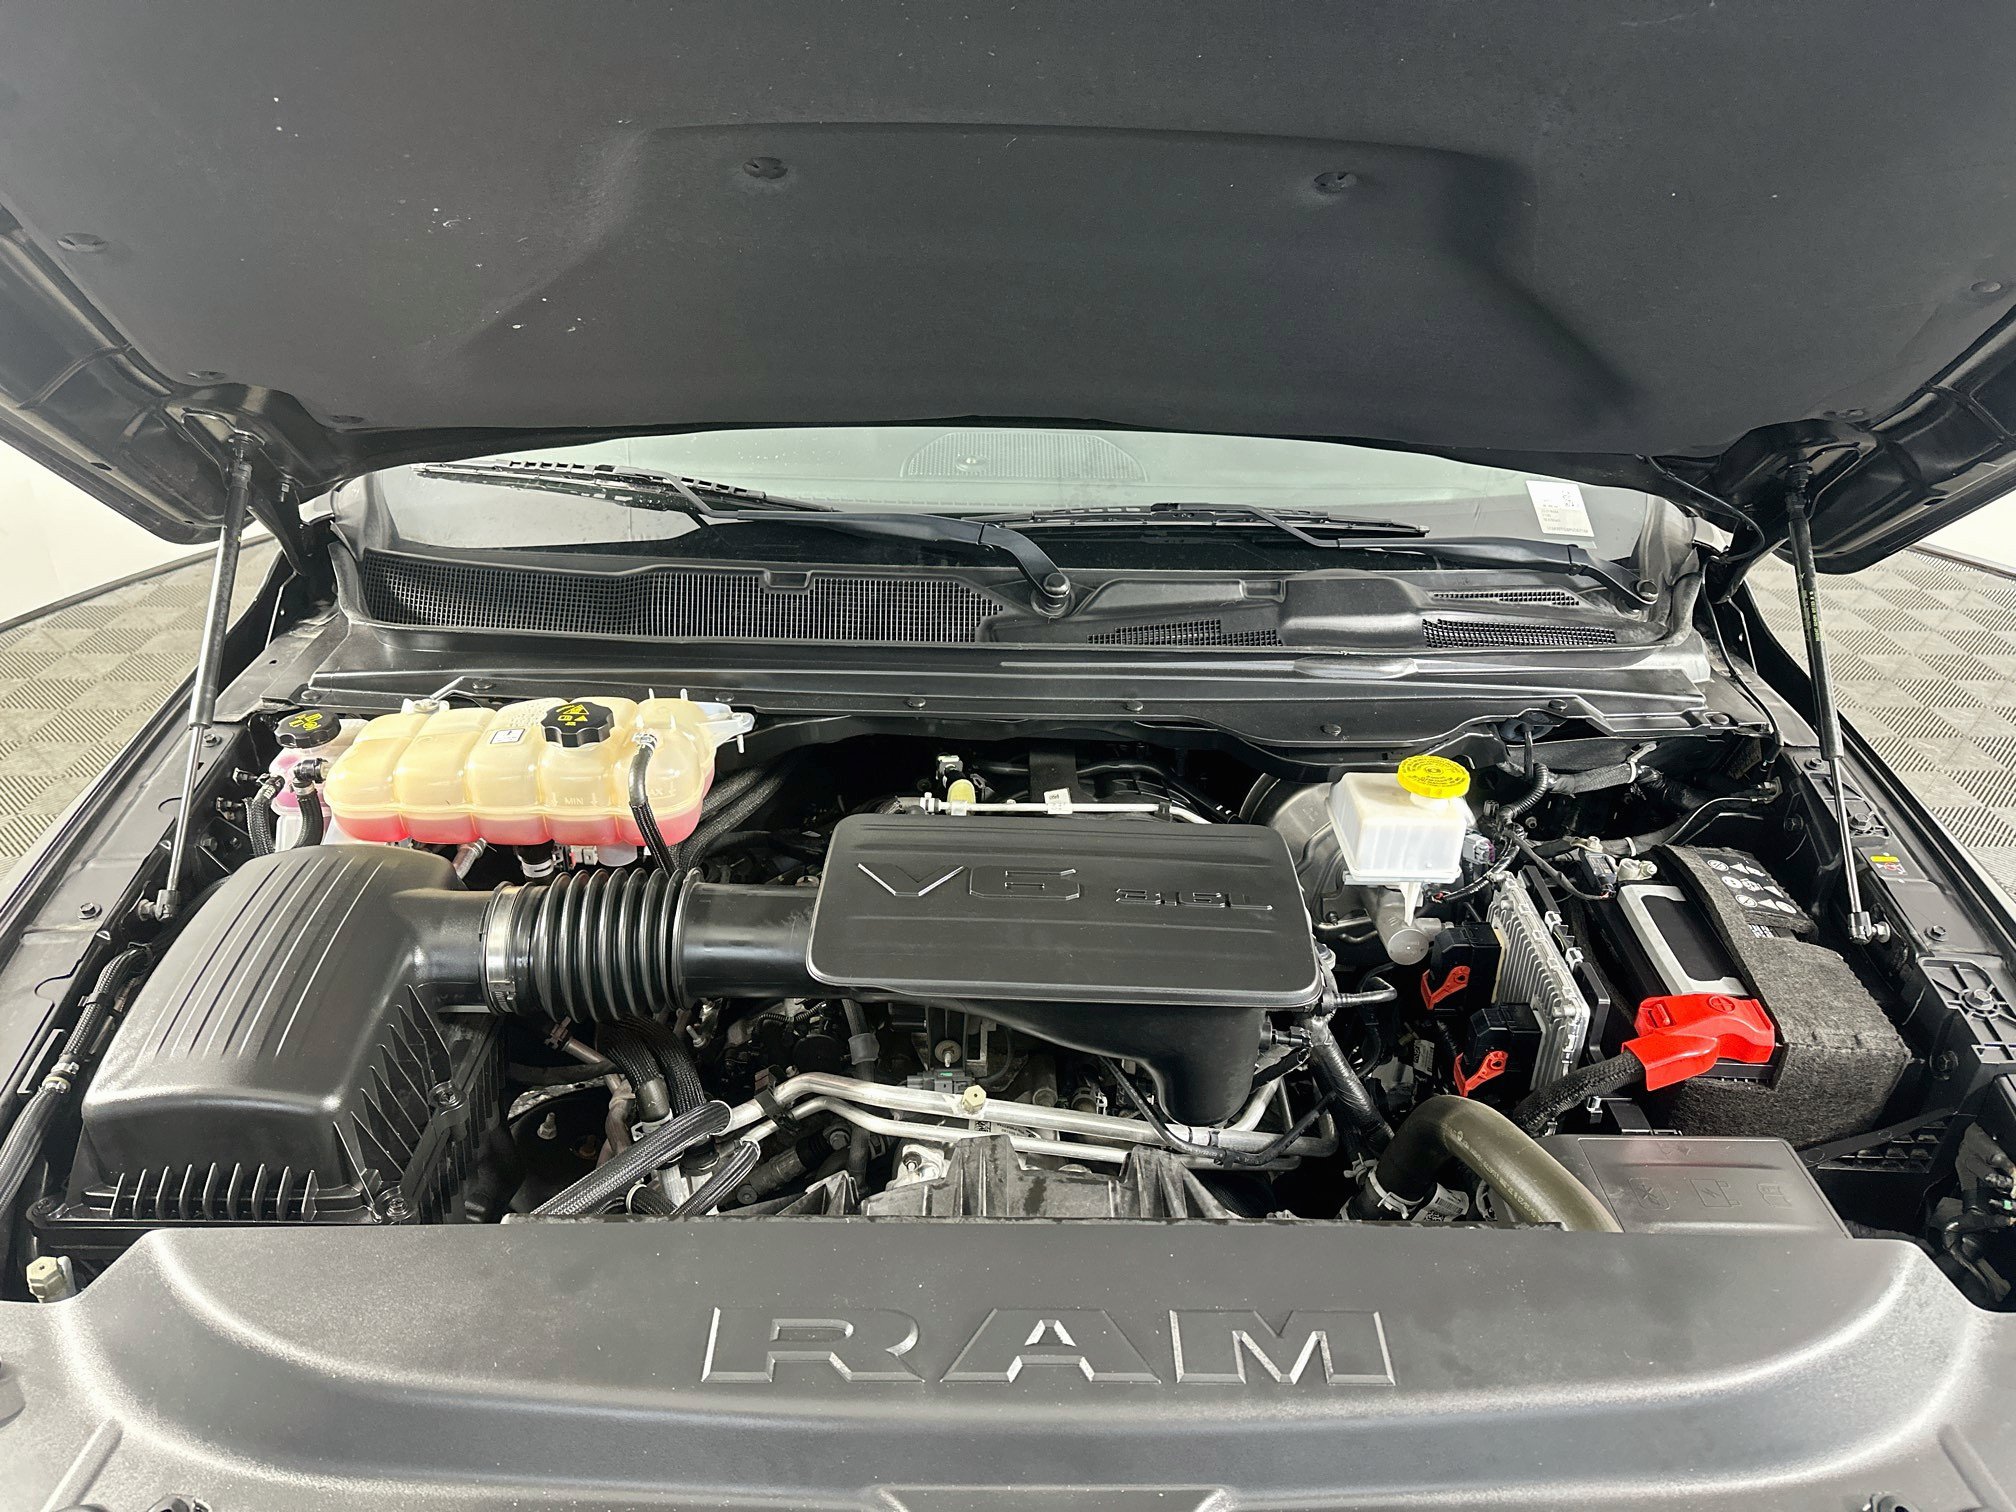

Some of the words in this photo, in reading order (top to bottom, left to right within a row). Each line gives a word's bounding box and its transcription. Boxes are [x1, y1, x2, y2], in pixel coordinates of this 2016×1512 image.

[564, 796, 584, 806] MIN
[857, 862, 1081, 901] V6
[700, 1306, 1397, 1384] RAM
